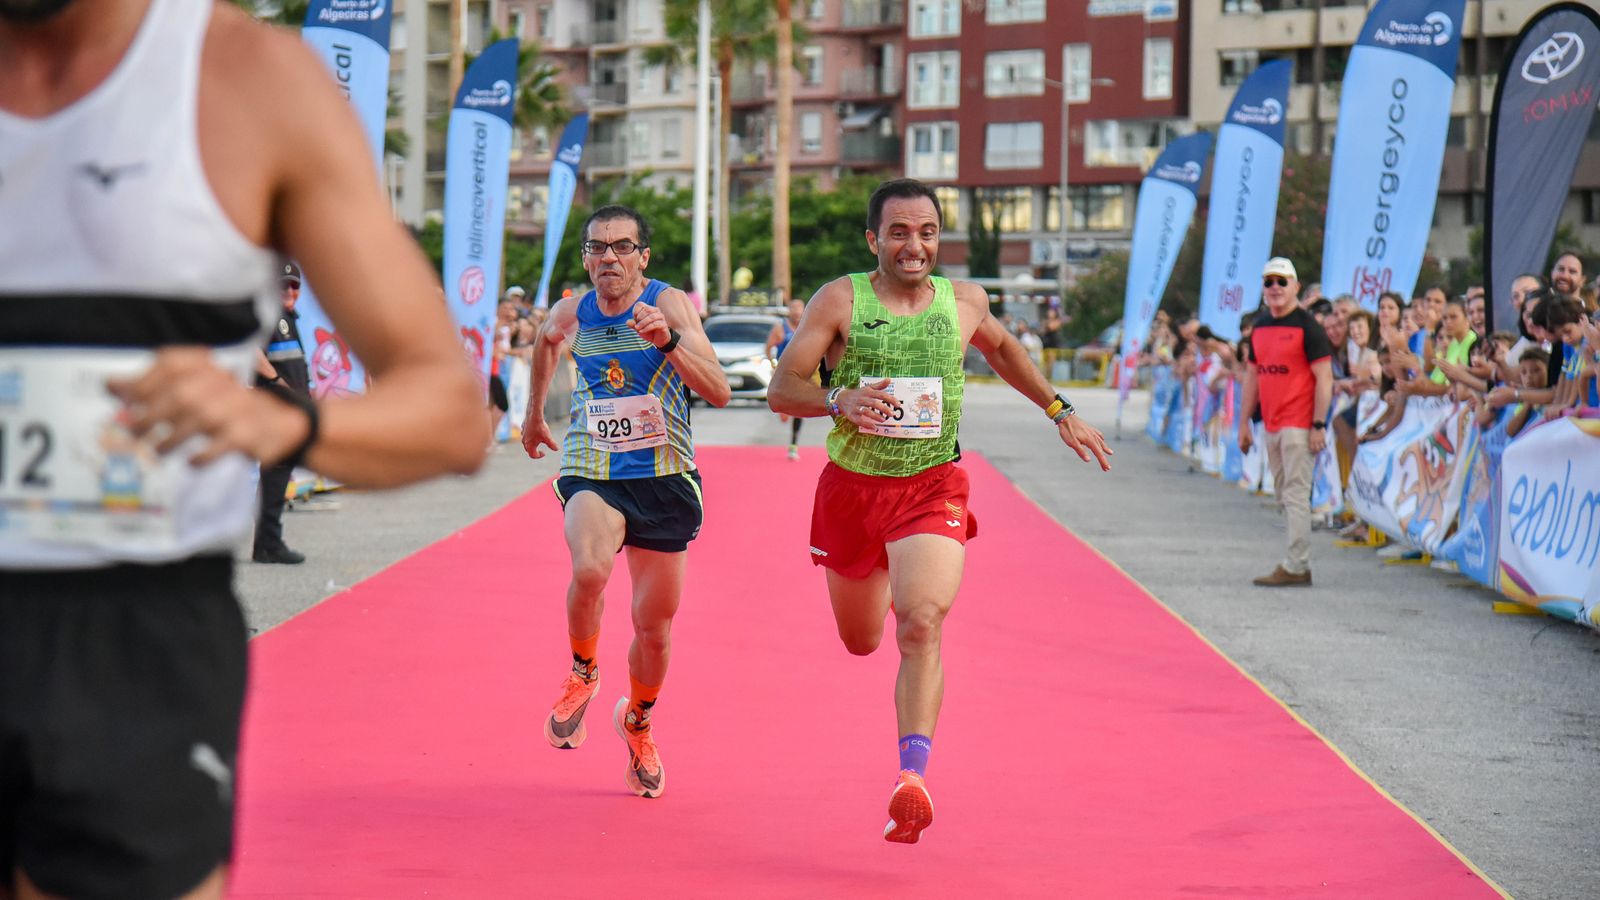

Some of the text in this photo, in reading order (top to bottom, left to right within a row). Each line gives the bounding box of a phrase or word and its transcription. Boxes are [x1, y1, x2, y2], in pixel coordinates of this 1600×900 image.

[318, 7, 370, 23] Algeciras
[1374, 28, 1432, 46] Algeciras
[1366, 77, 1409, 260] Sergeyco
[1226, 146, 1255, 279] Sergeyco
[589, 405, 602, 414] XXI
[597, 418, 632, 439] 929
